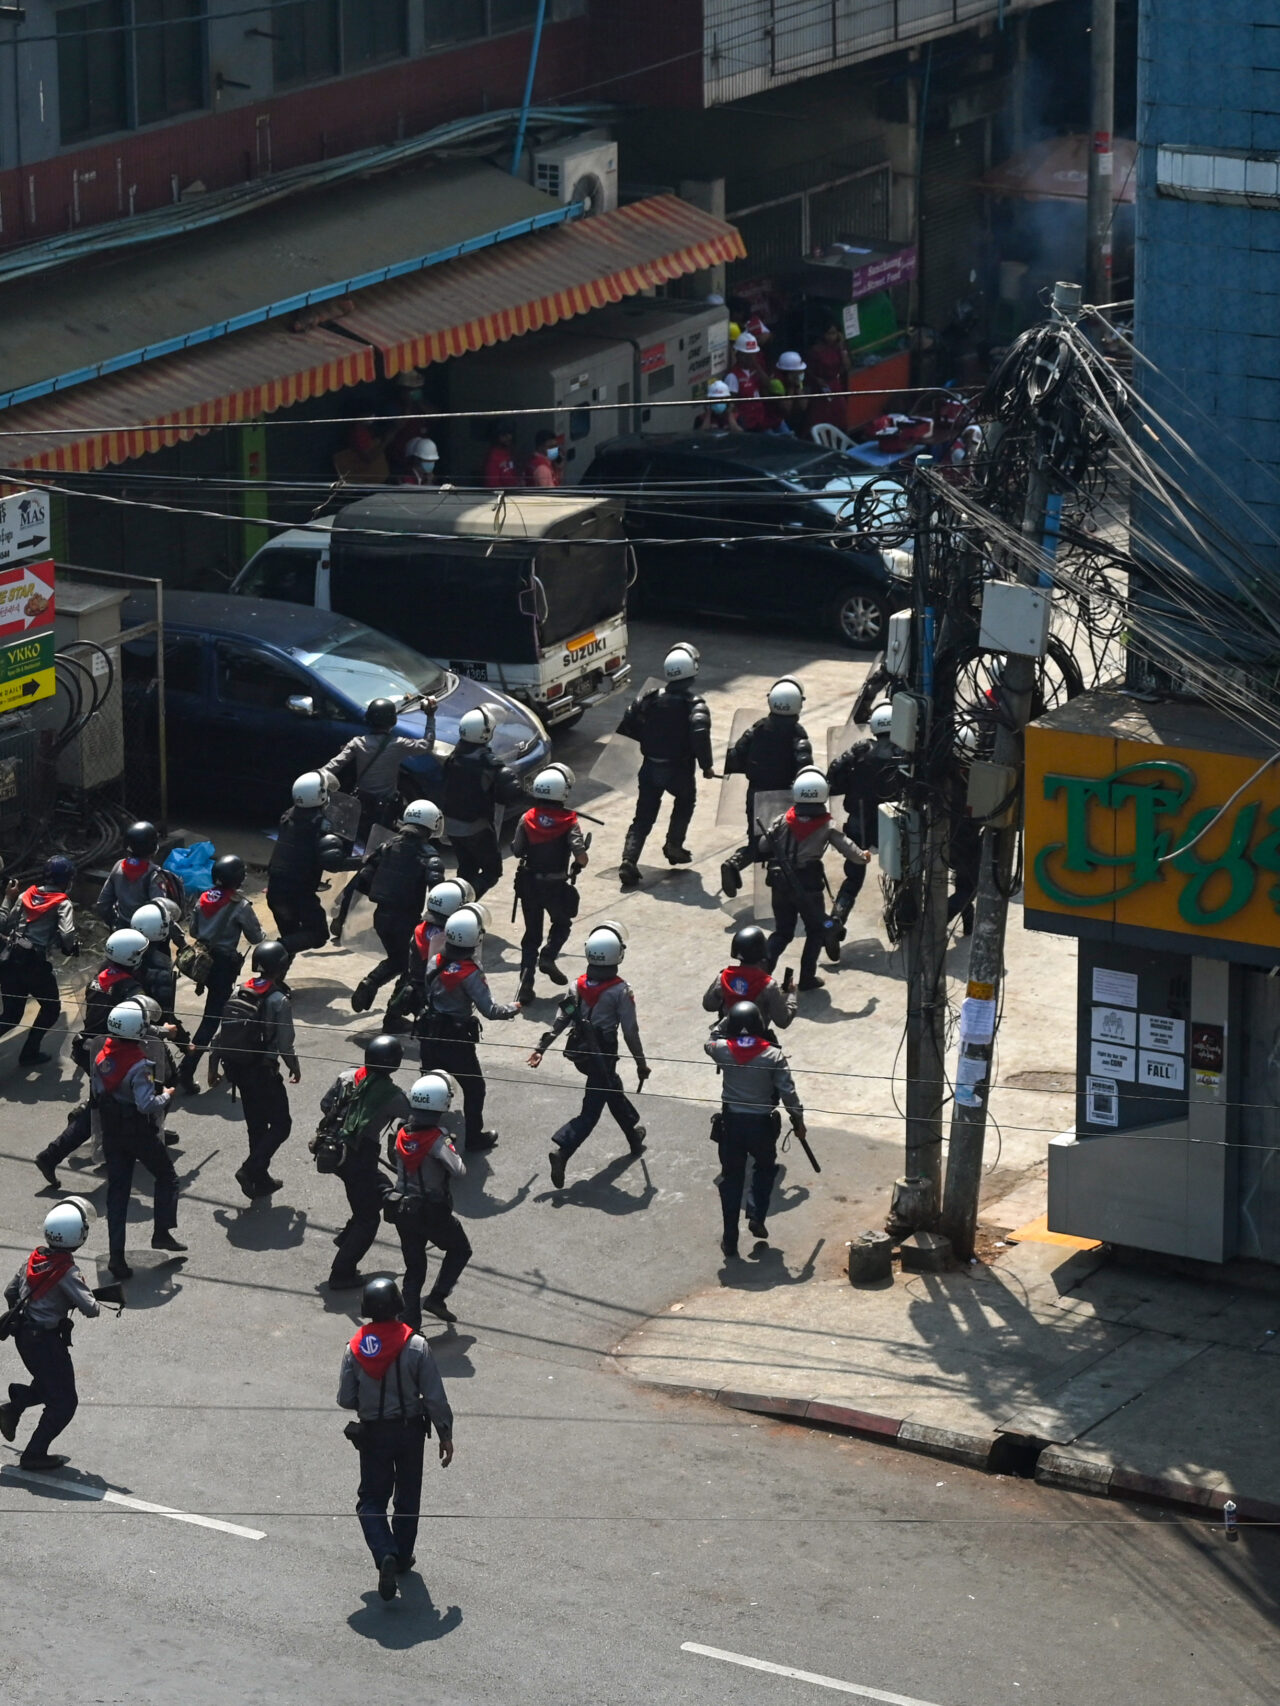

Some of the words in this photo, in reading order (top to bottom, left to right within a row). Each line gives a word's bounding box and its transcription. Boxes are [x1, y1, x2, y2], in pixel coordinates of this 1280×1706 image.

[20, 506, 45, 527] MAS
[8, 583, 35, 602] STAR
[8, 643, 41, 664] YKKO
[563, 638, 606, 667] SUZUKI
[877, 720, 892, 728] POLIC
[1147, 1063, 1170, 1079] FALL
